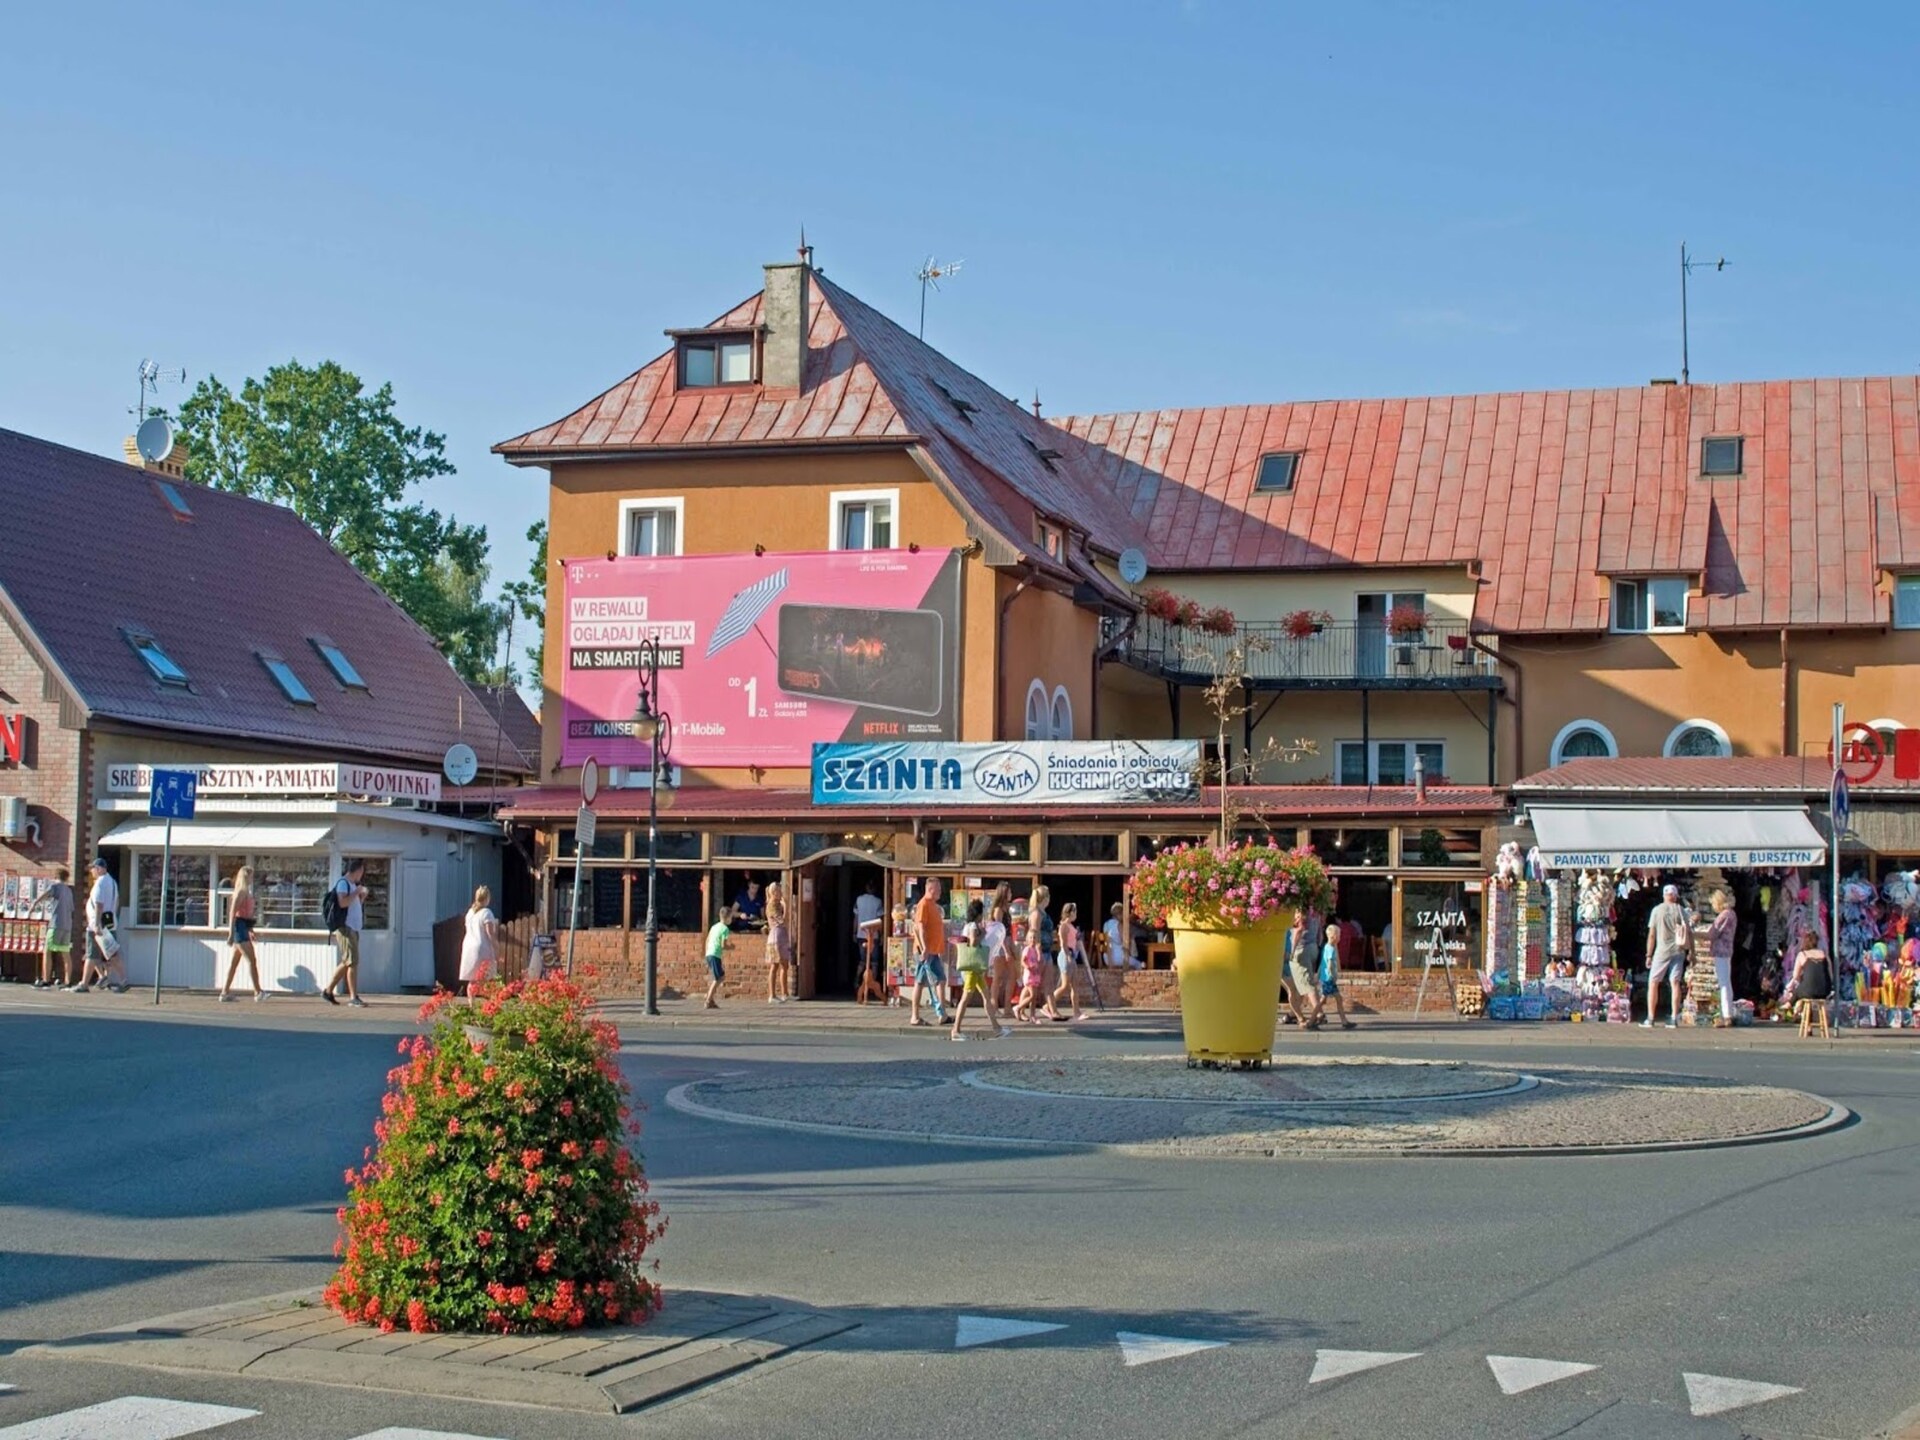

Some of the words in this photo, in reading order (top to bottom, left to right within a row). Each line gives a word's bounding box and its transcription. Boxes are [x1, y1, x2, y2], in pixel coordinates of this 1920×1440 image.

[574, 602, 586, 617] W
[589, 601, 644, 617] REWALU
[573, 626, 633, 644] OGLĄDAJ
[637, 625, 692, 641] NETFLIX
[572, 651, 592, 667] NA
[728, 677, 741, 687] OD
[743, 676, 757, 718] 1
[570, 722, 592, 736] BEZ
[681, 722, 726, 736] T-Mobile
[863, 722, 898, 735] NETFLIX
[1048, 752, 1118, 769] Śniadania
[1121, 755, 1126, 768] i
[1130, 755, 1179, 771] obiady
[111, 769, 152, 787] SREB
[180, 769, 255, 787] RSZTYN
[265, 769, 336, 790] PAMIĄTKI
[352, 769, 430, 796] UPOMINKI
[823, 757, 963, 792] SZANTA
[981, 769, 1035, 791] SZANTA
[1048, 771, 1111, 790] KUCHNI
[1113, 771, 1191, 789] POLSKIEJ
[1623, 853, 1678, 865] ZABAWKI
[1690, 853, 1737, 864] MUSZLE
[1749, 851, 1812, 863] BURSZTYN
[1416, 910, 1467, 928] SZANTA
